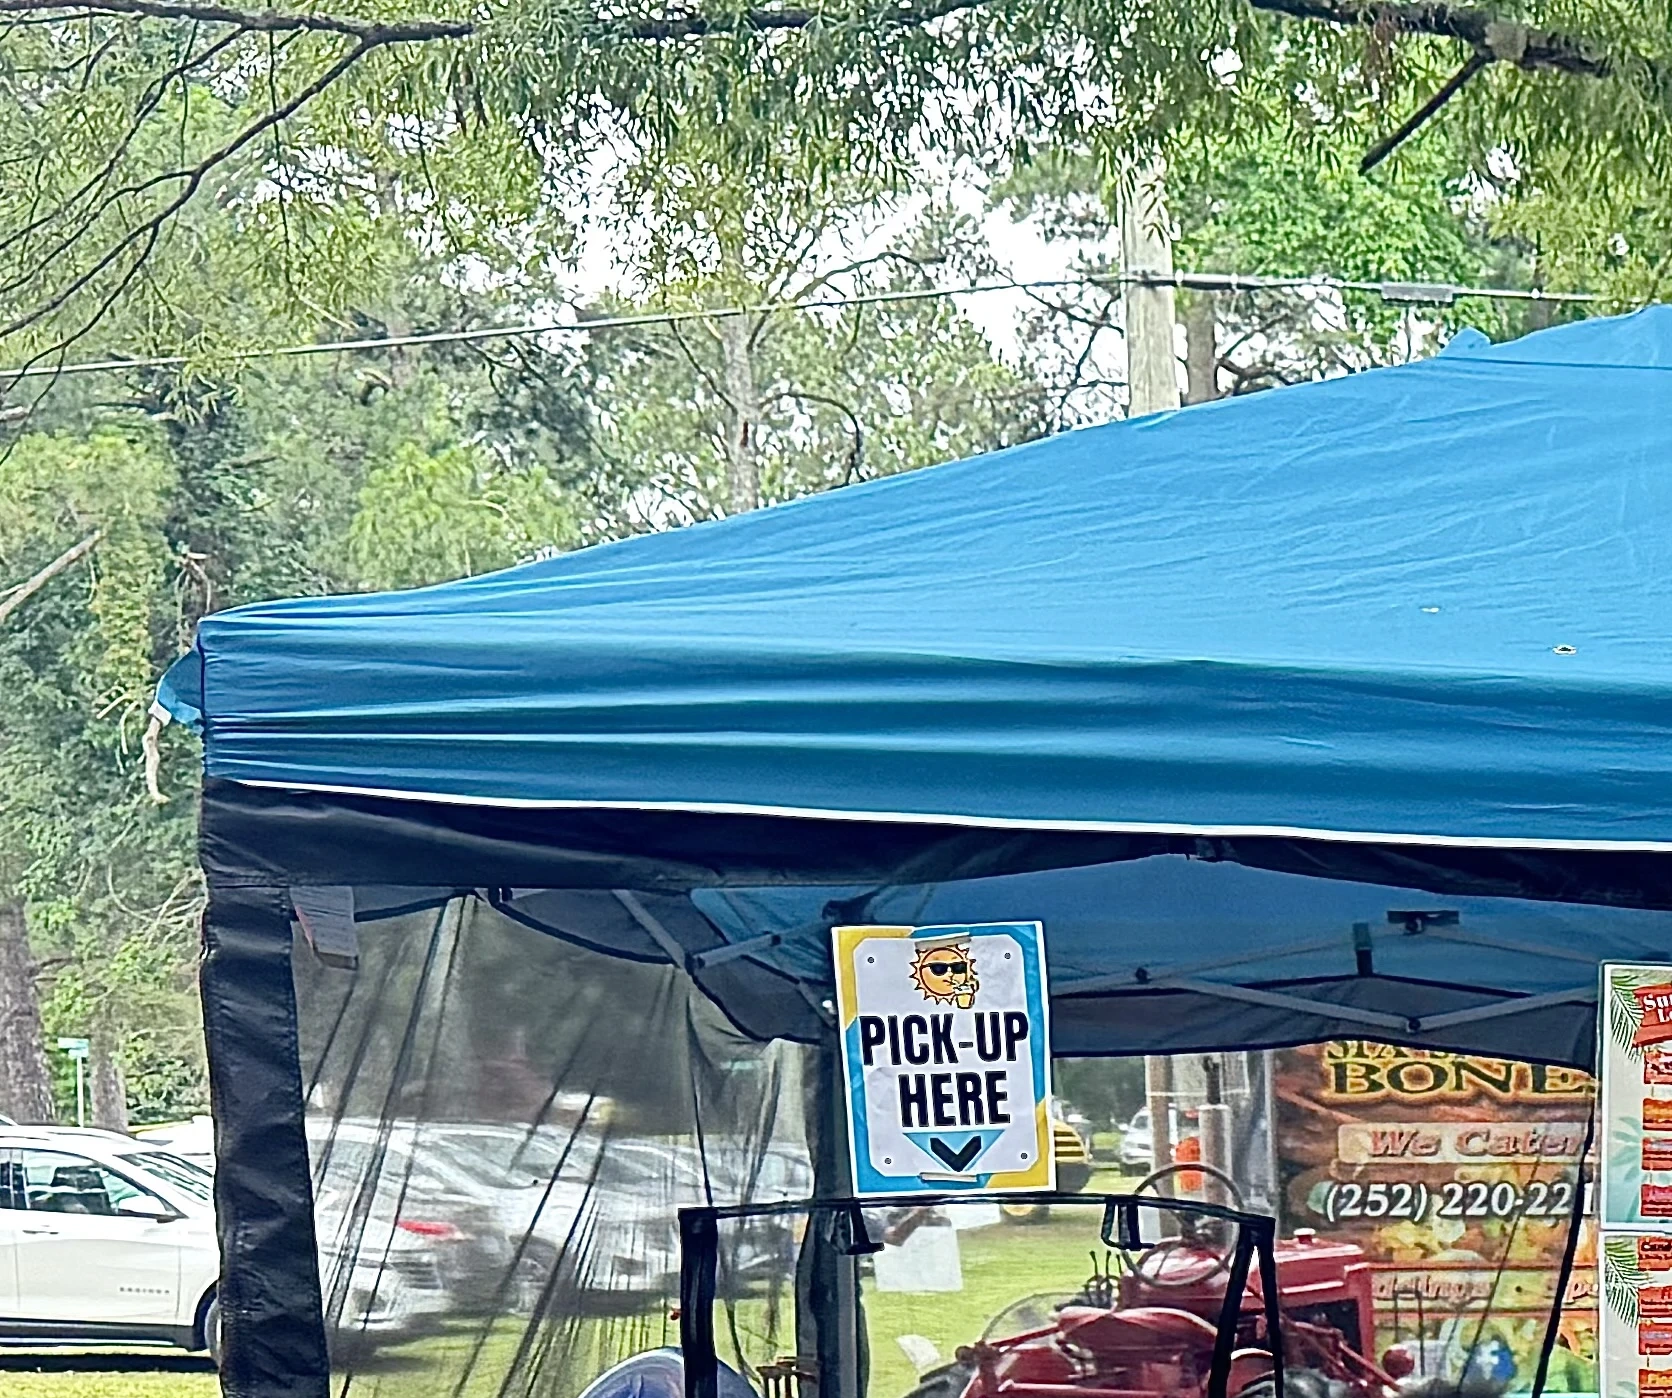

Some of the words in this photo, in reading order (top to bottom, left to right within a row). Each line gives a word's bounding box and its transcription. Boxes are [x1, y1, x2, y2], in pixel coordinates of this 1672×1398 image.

[859, 1011, 1029, 1066] PICK-UP
[898, 1070, 1011, 1128] HERE
[1369, 1128, 1441, 1157] We
[1326, 1182, 1428, 1222] (252)
